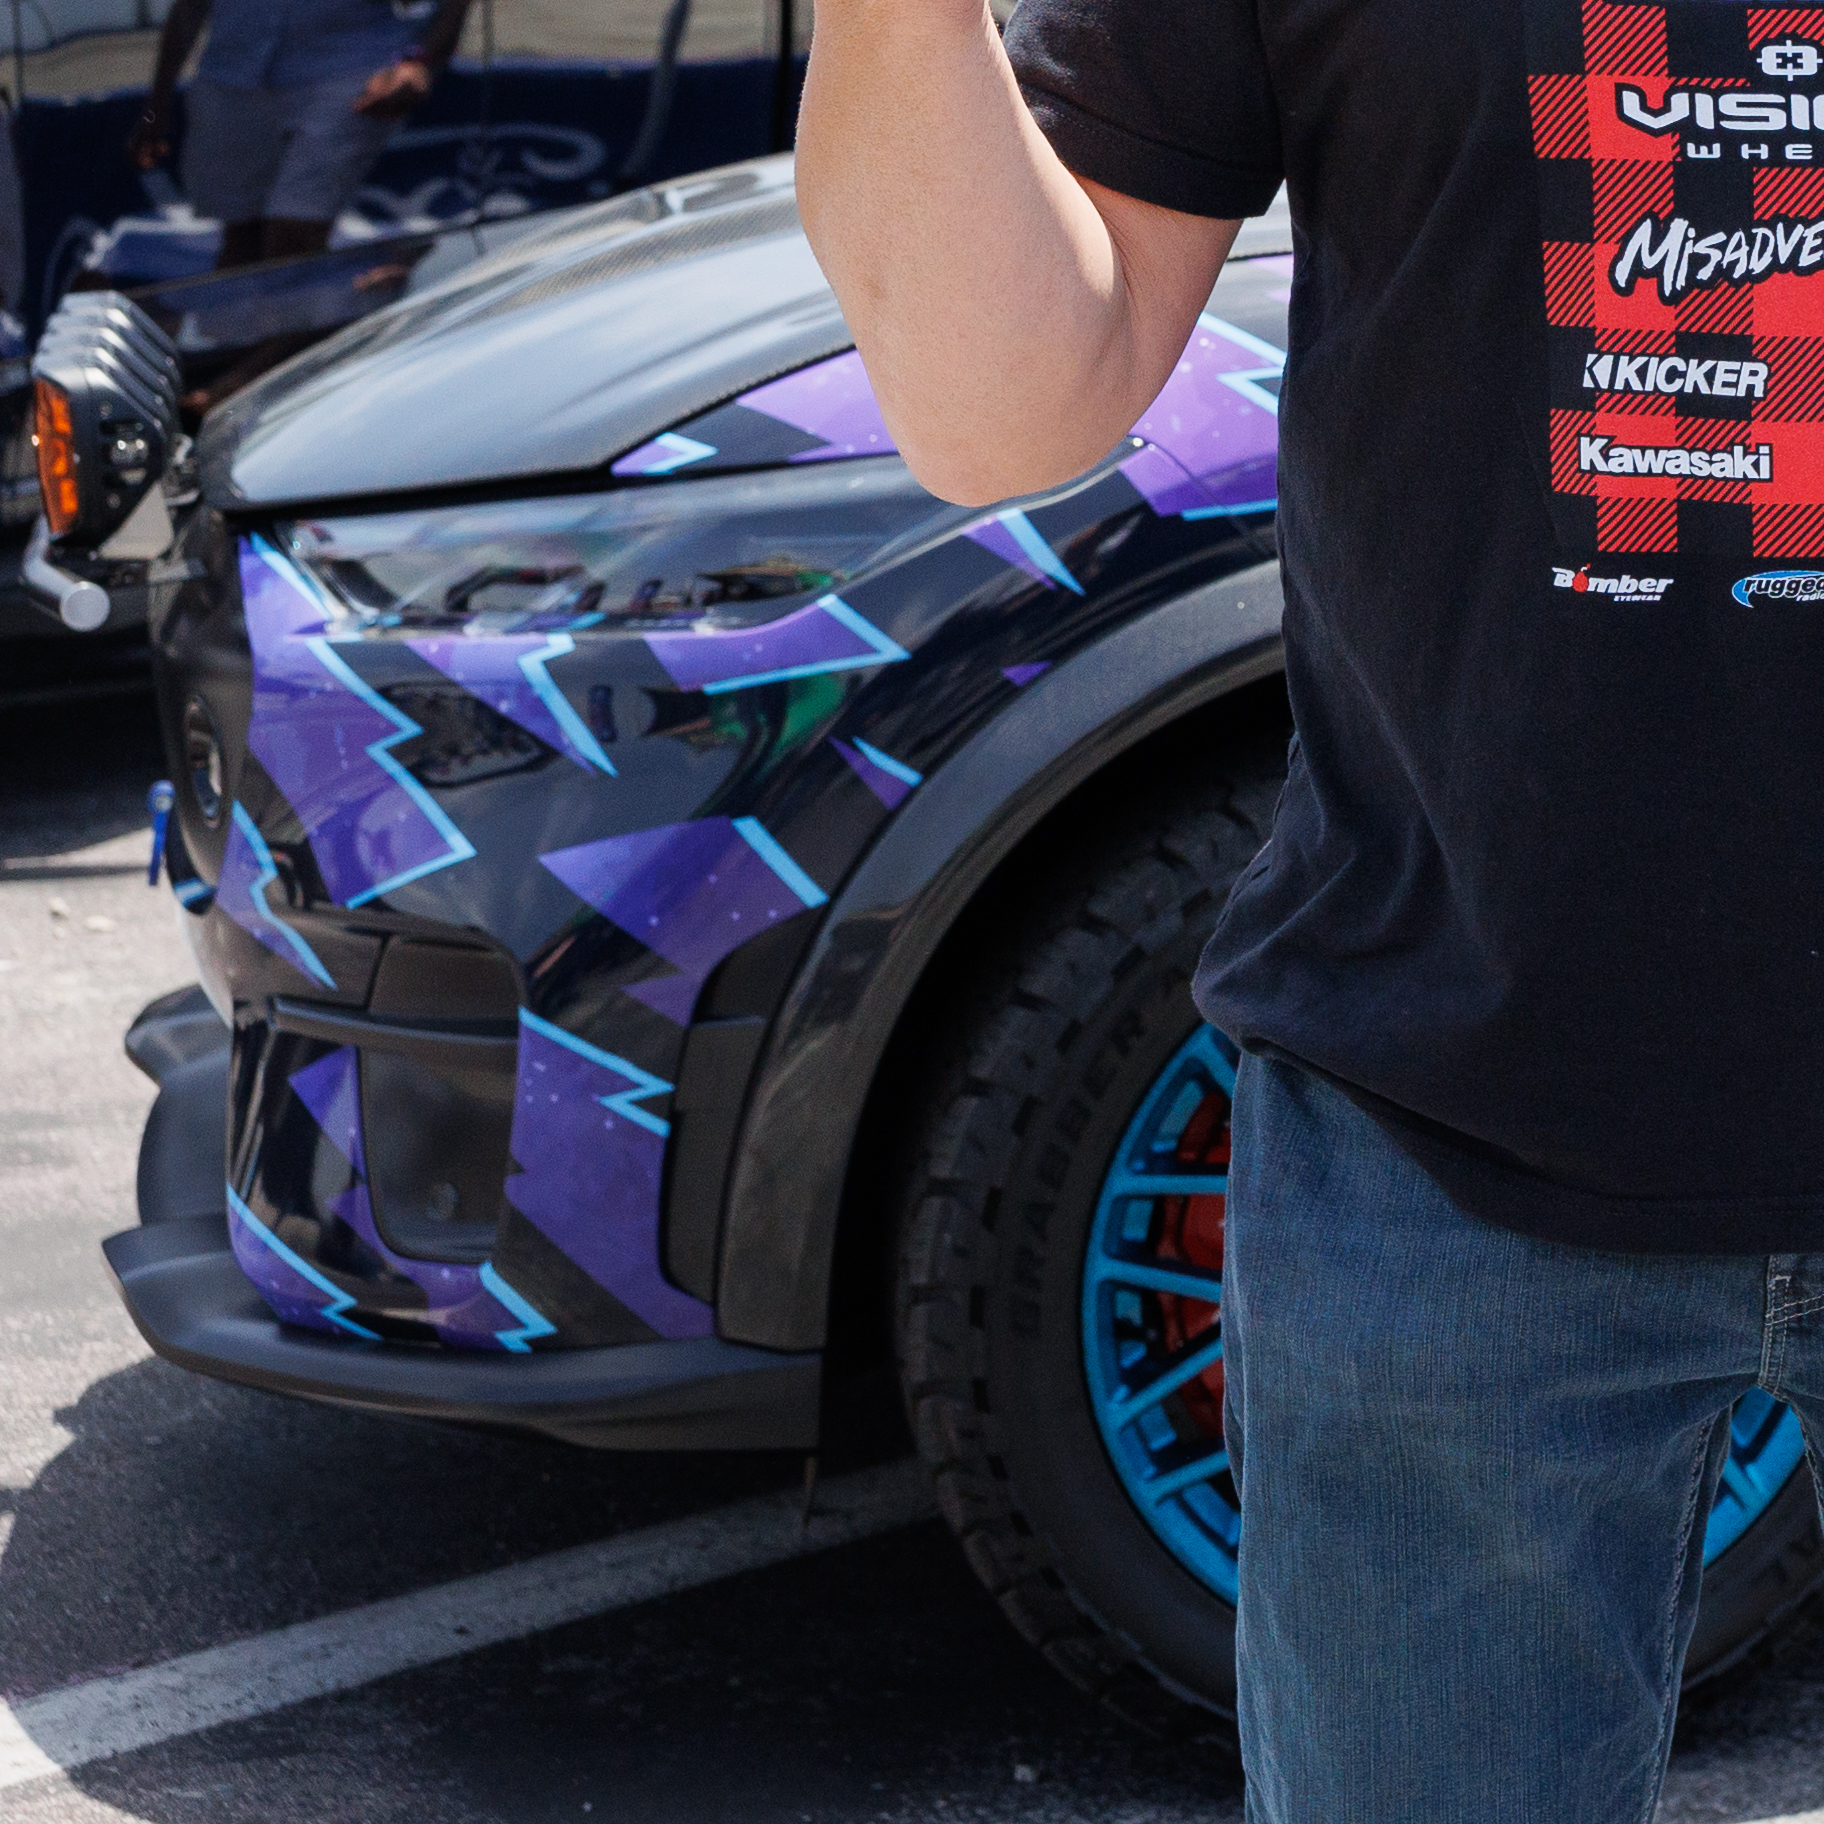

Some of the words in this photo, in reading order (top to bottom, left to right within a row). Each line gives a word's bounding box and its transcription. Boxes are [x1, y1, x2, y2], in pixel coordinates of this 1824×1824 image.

[1614, 357, 1768, 397] KICKER
[1580, 438, 1770, 479] Kawasaki
[1552, 564, 1674, 594] Bomber
